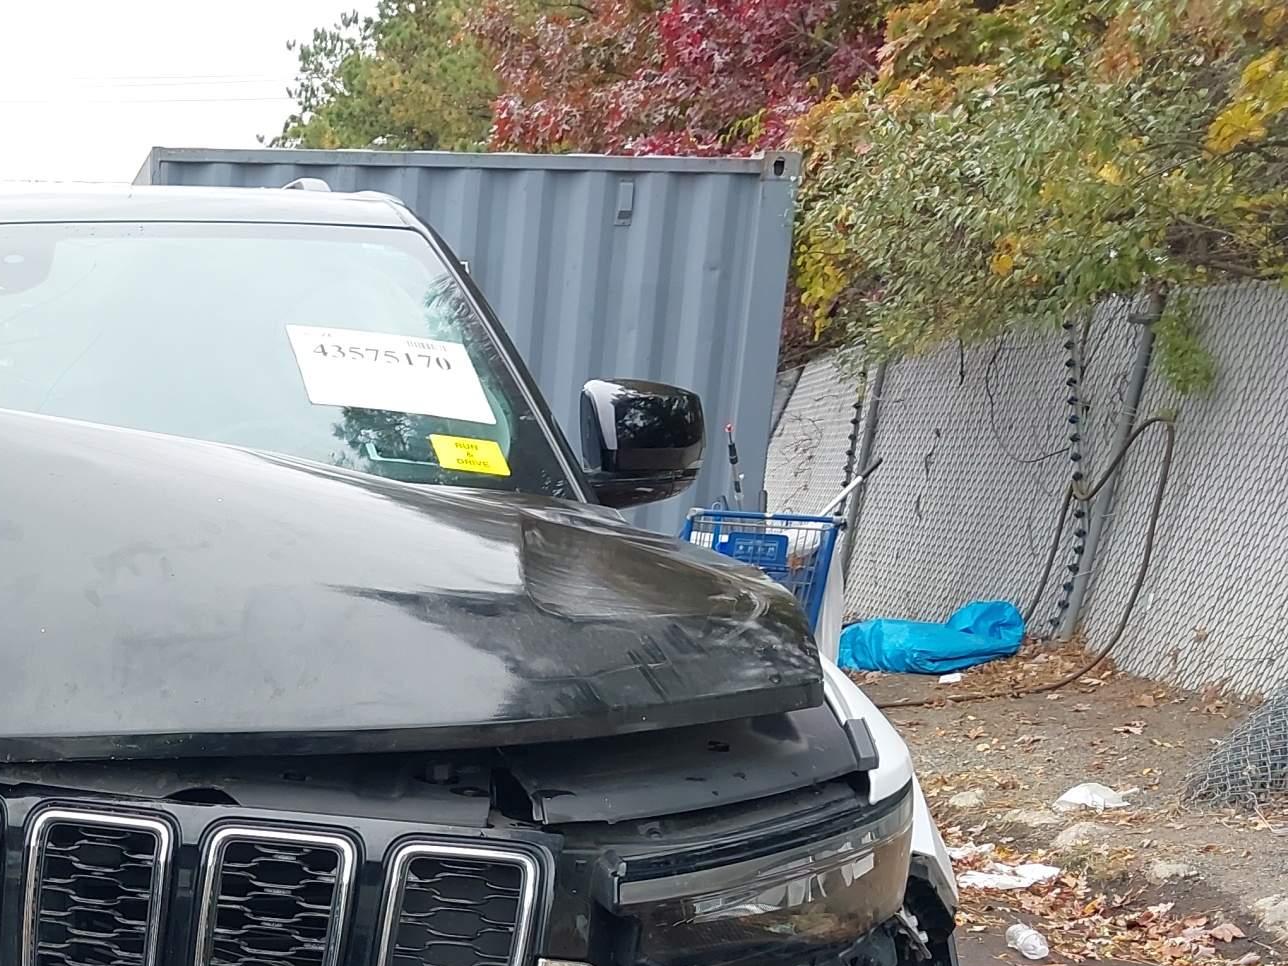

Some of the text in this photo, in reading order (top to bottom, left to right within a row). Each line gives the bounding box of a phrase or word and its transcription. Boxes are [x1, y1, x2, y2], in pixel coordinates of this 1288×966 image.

[313, 343, 451, 370] 43575170
[454, 442, 479, 451] RUN
[456, 458, 489, 467] DRIVE
